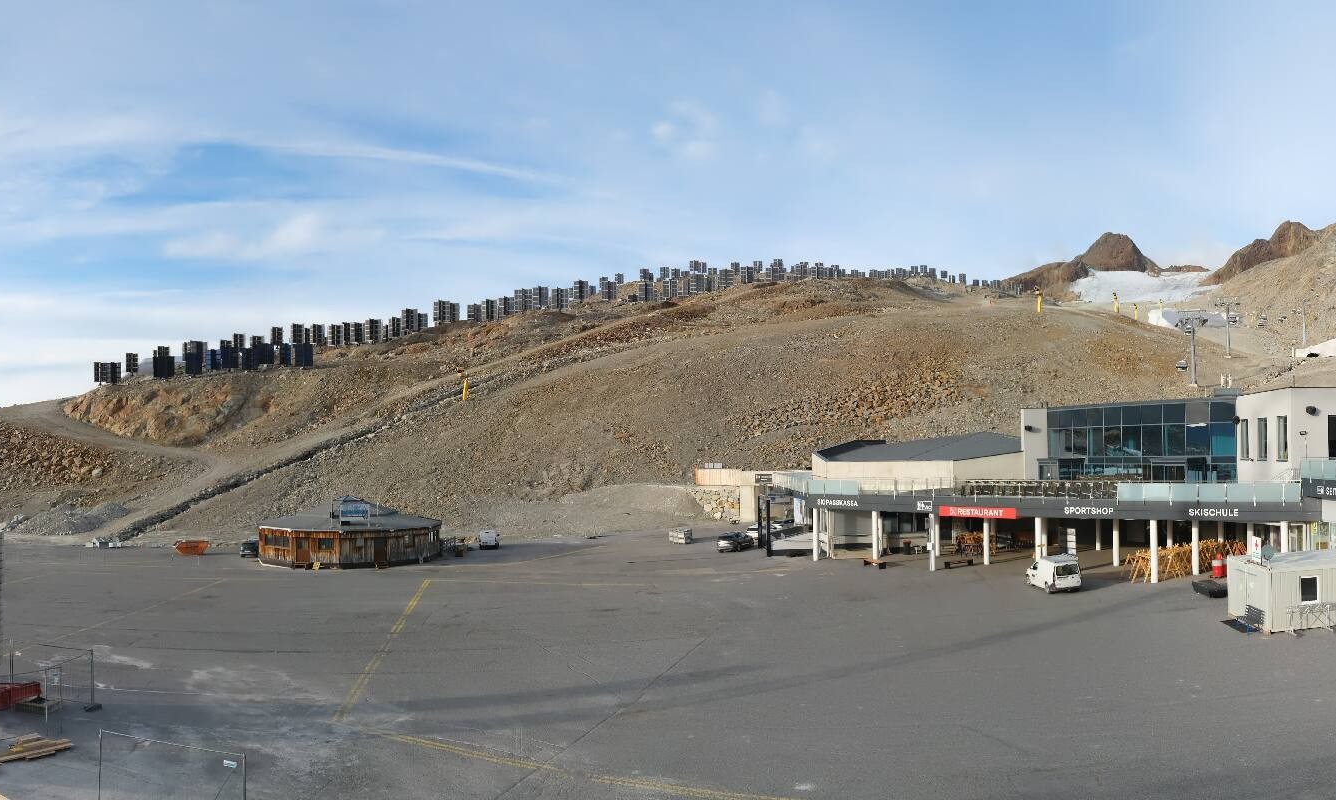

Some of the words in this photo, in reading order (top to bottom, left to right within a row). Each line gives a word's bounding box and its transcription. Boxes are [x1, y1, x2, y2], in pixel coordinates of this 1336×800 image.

[957, 508, 1004, 517] RESTAURANT
[1064, 506, 1114, 515] SPORTSHOP
[1188, 508, 1239, 517] SKISCHULE
